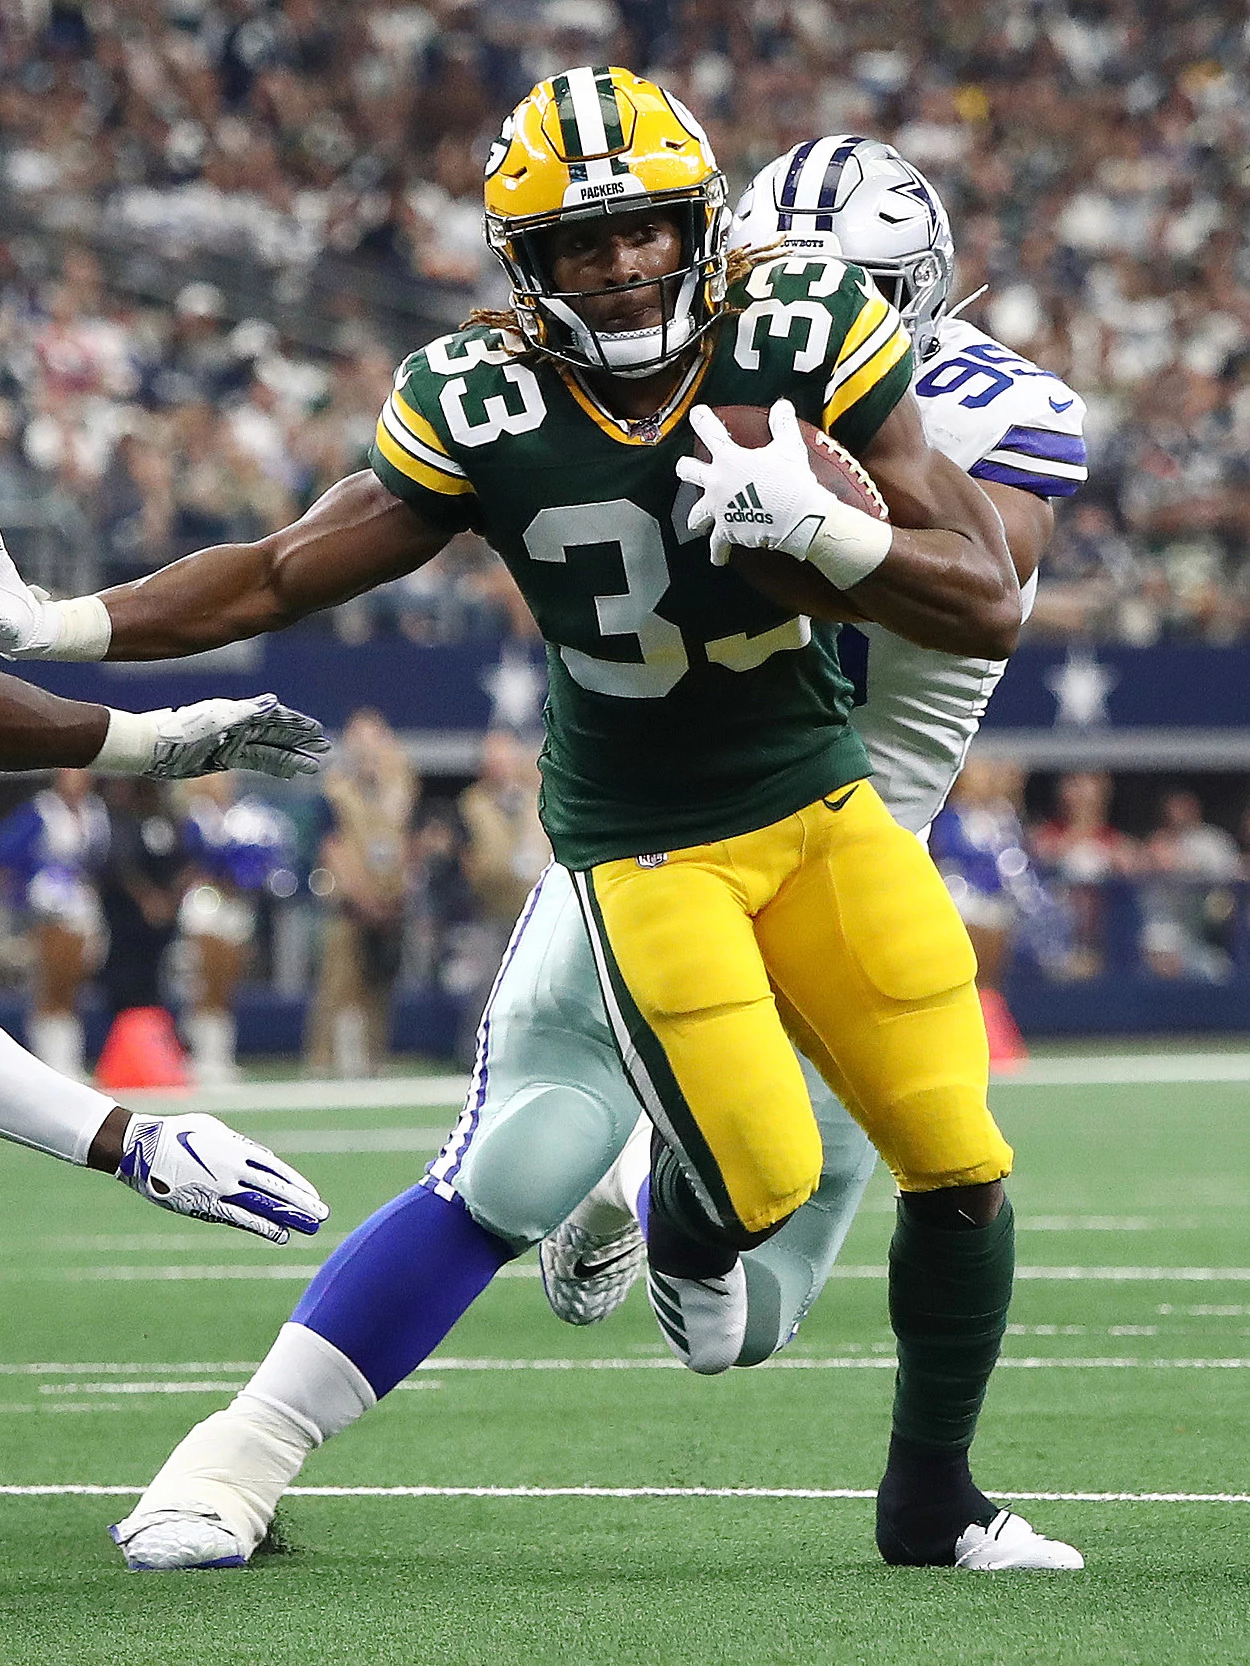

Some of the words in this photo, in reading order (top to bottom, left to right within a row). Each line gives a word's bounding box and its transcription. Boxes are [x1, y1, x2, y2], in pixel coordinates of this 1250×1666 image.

[580, 181, 625, 201] PACKERS
[733, 256, 848, 373] 33
[425, 328, 548, 448] 33
[723, 508, 774, 525] adidas
